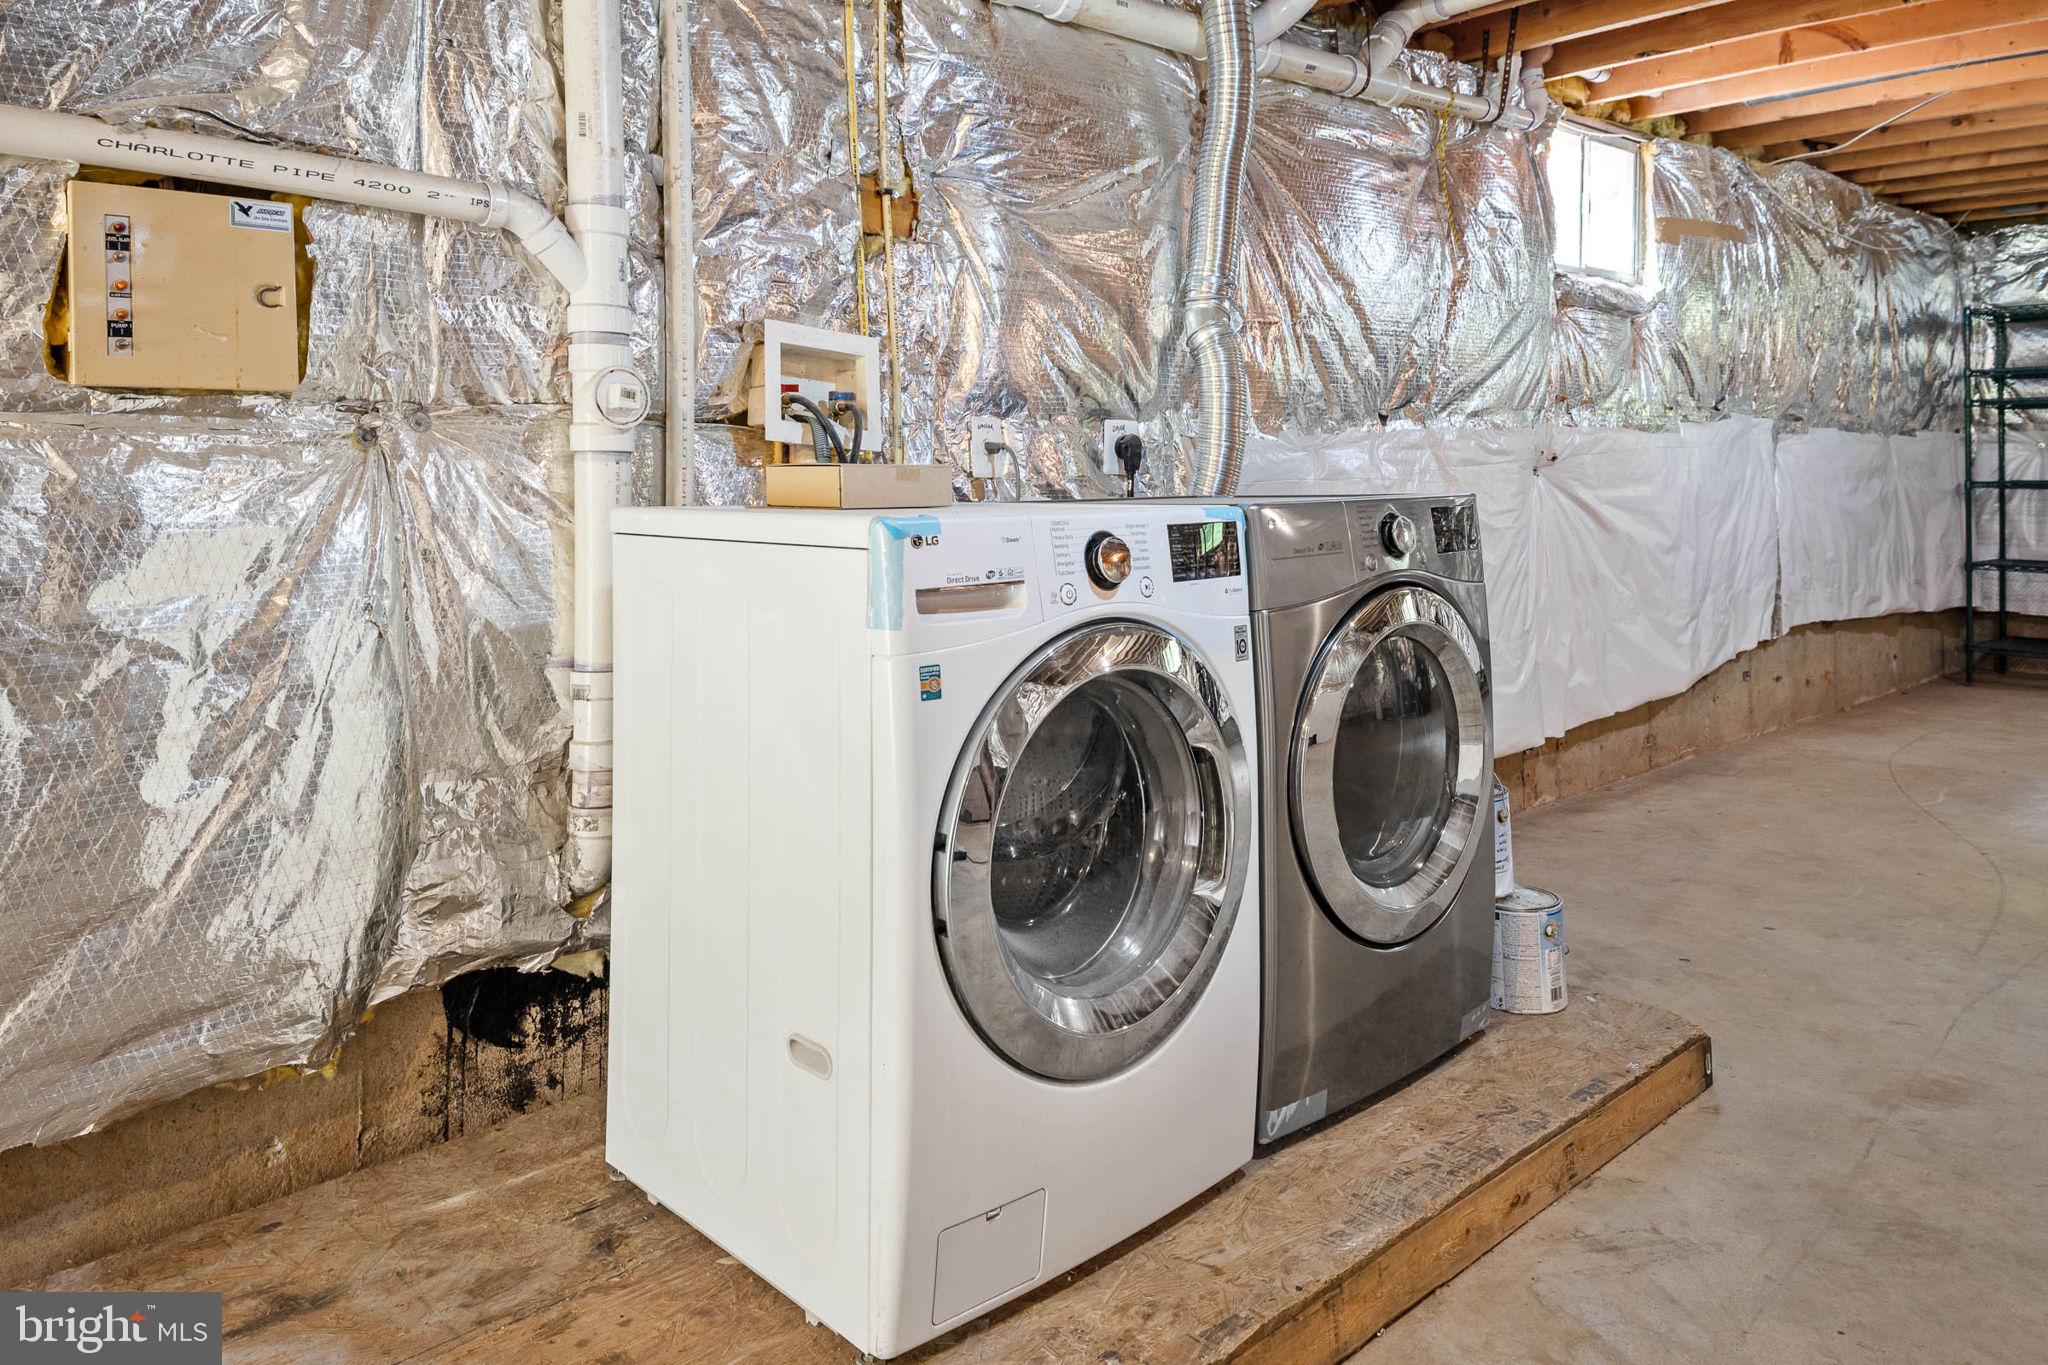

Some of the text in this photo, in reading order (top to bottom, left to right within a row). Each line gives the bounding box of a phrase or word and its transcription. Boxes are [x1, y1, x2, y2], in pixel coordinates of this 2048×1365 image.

[97, 138, 255, 169] CHARLOTTE
[273, 164, 336, 182] PIPE
[352, 178, 412, 195] 4200
[925, 535, 939, 546] LG
[946, 574, 980, 585] Direct Drive
